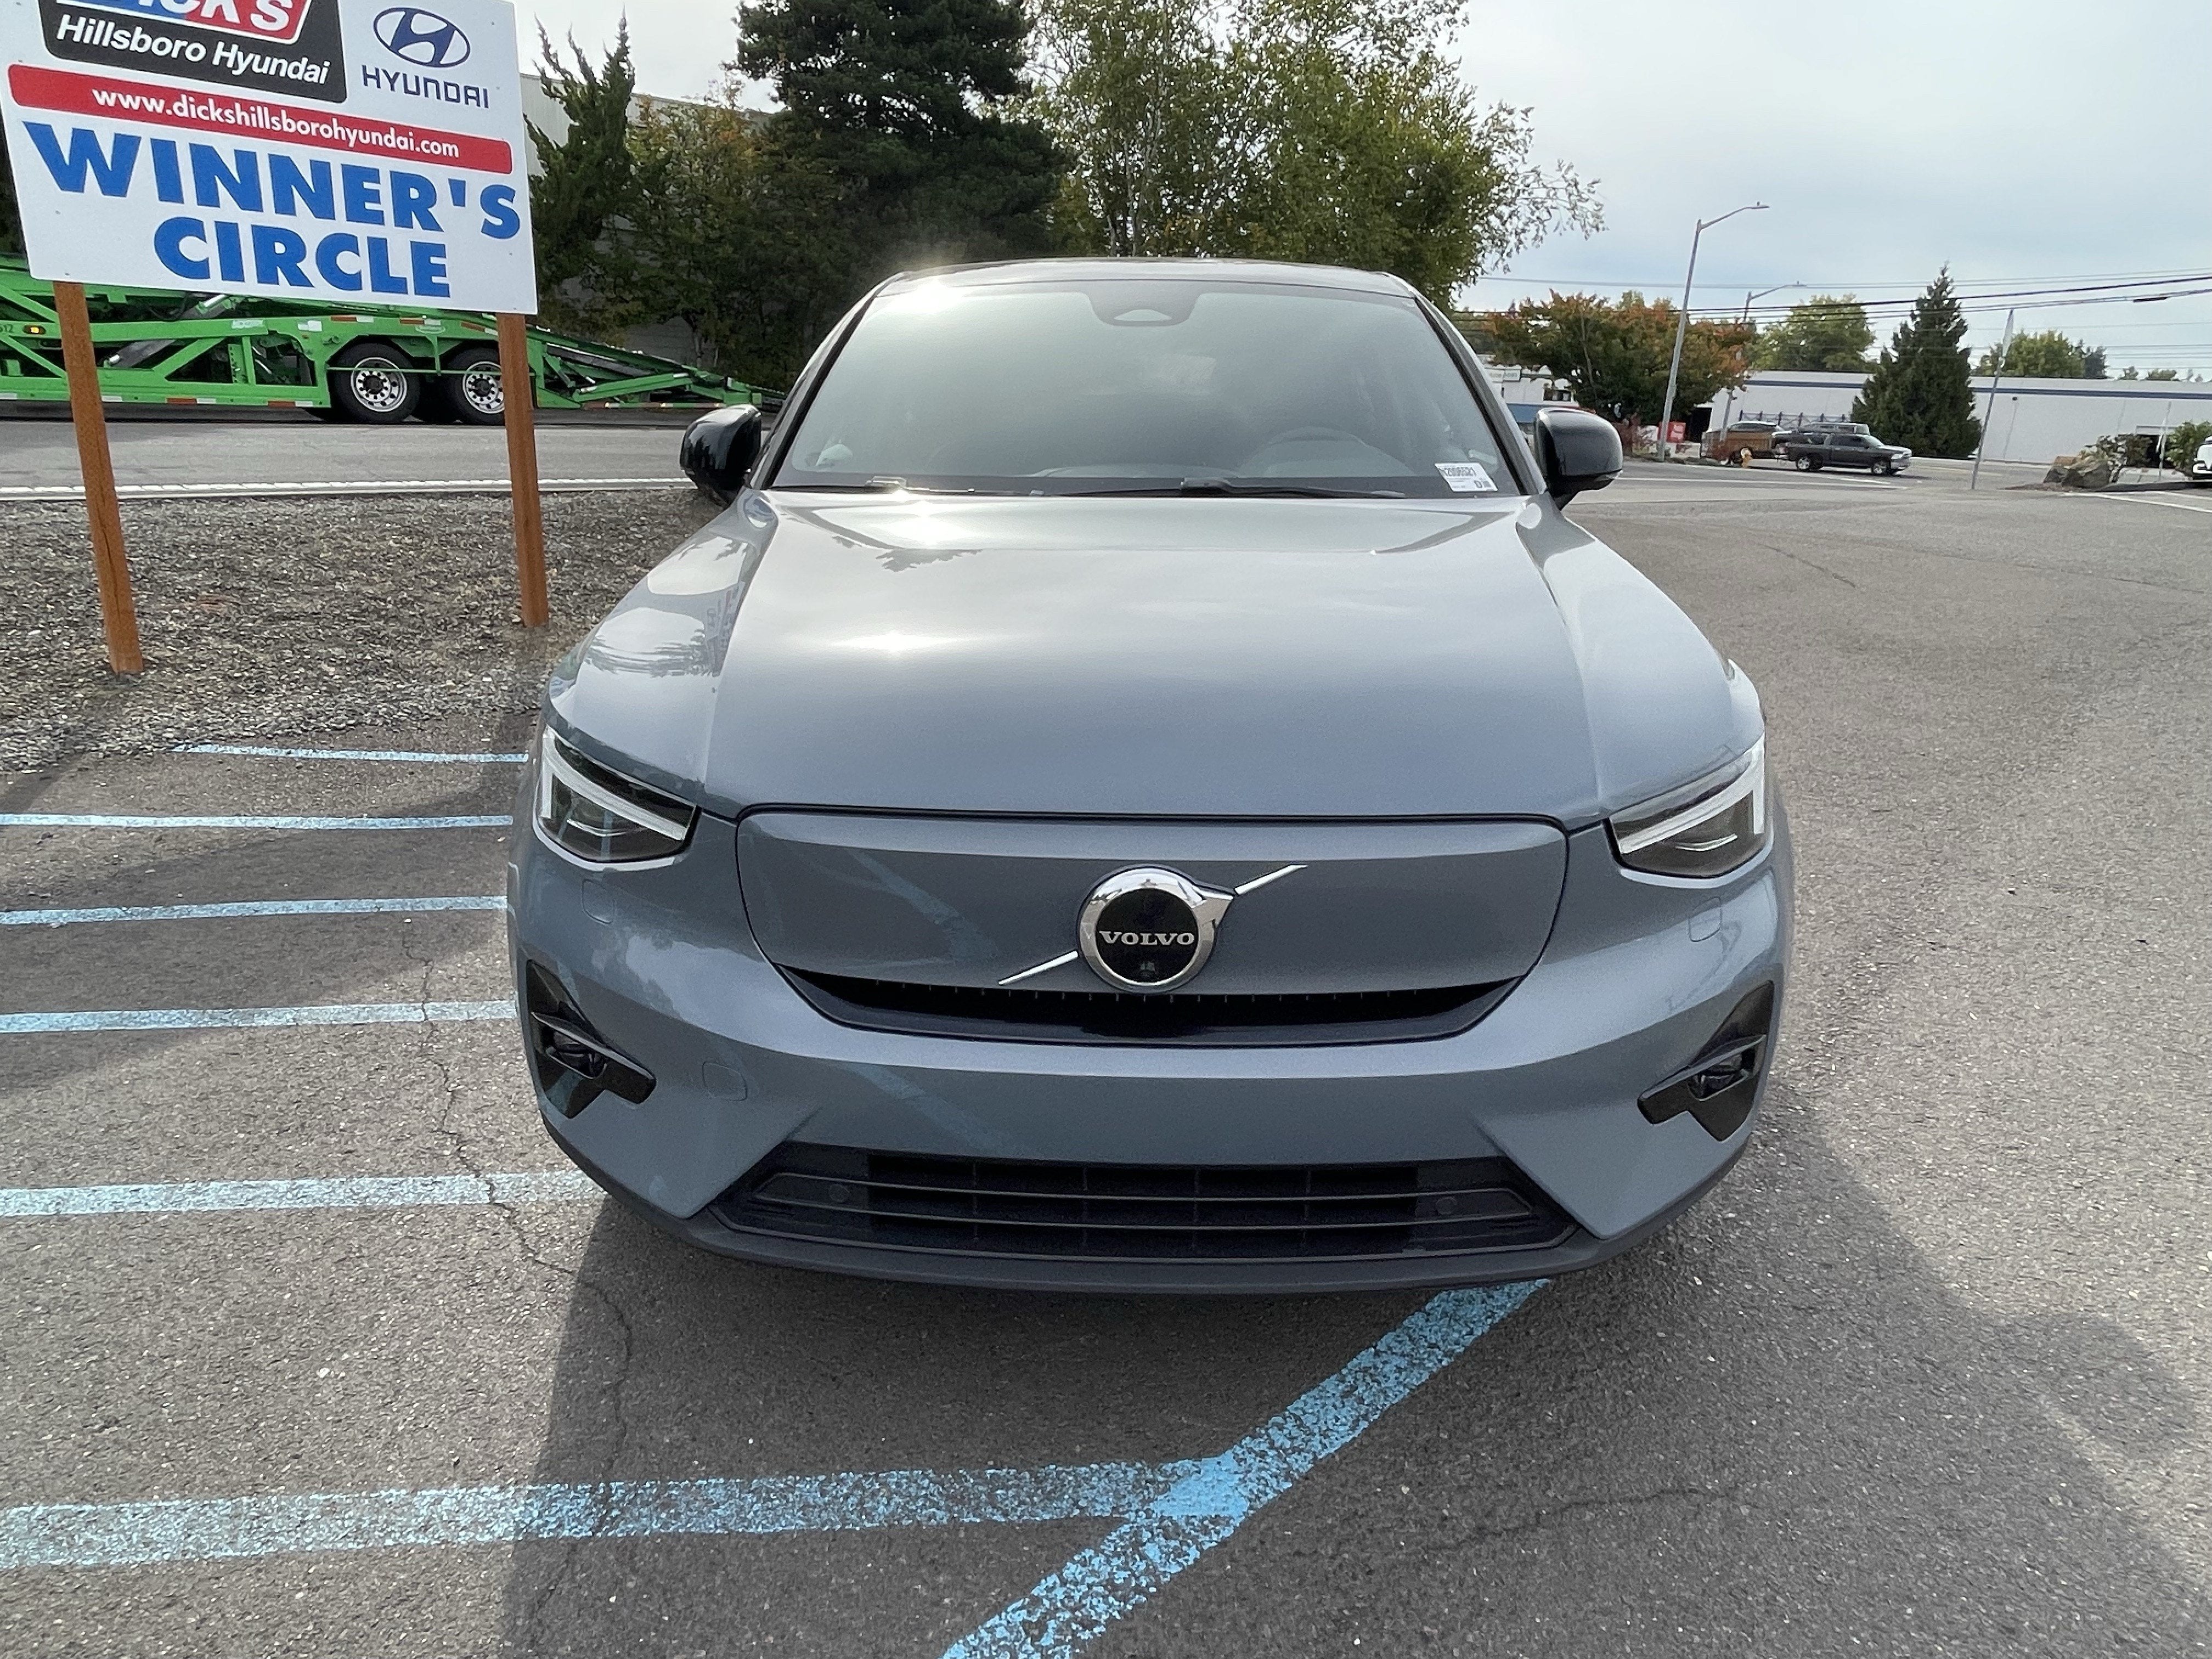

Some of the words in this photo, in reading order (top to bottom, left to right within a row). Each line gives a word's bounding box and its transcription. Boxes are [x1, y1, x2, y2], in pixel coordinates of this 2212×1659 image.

[56, 14, 206, 62] Hillsboro
[212, 41, 330, 84] Hyundai
[361, 64, 489, 109] HYUNDAI
[92, 88, 460, 158] www.dickshillsborohyundai.com
[22, 121, 521, 239] WINNER'S
[154, 216, 451, 297] CIRCLE
[1098, 930, 1195, 946] VOLVO
